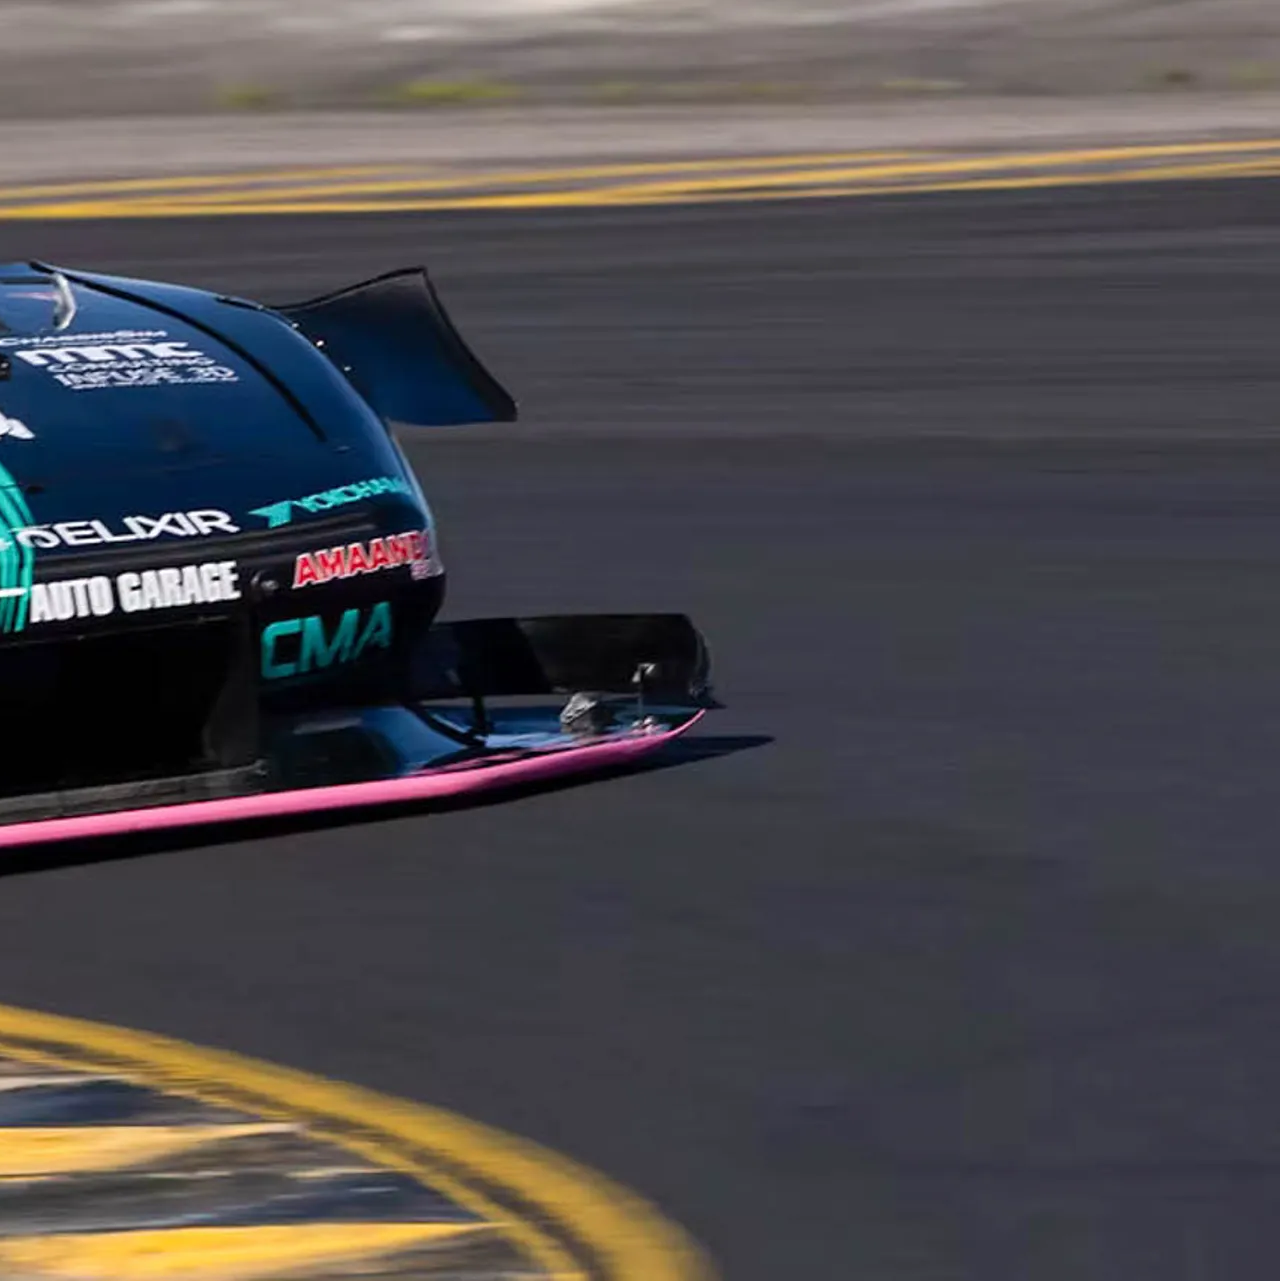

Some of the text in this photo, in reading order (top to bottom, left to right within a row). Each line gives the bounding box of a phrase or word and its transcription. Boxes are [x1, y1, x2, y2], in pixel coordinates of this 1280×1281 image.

[30, 575, 114, 623] AUTO
[117, 561, 241, 612] GARAGE
[260, 601, 393, 679] CMA
